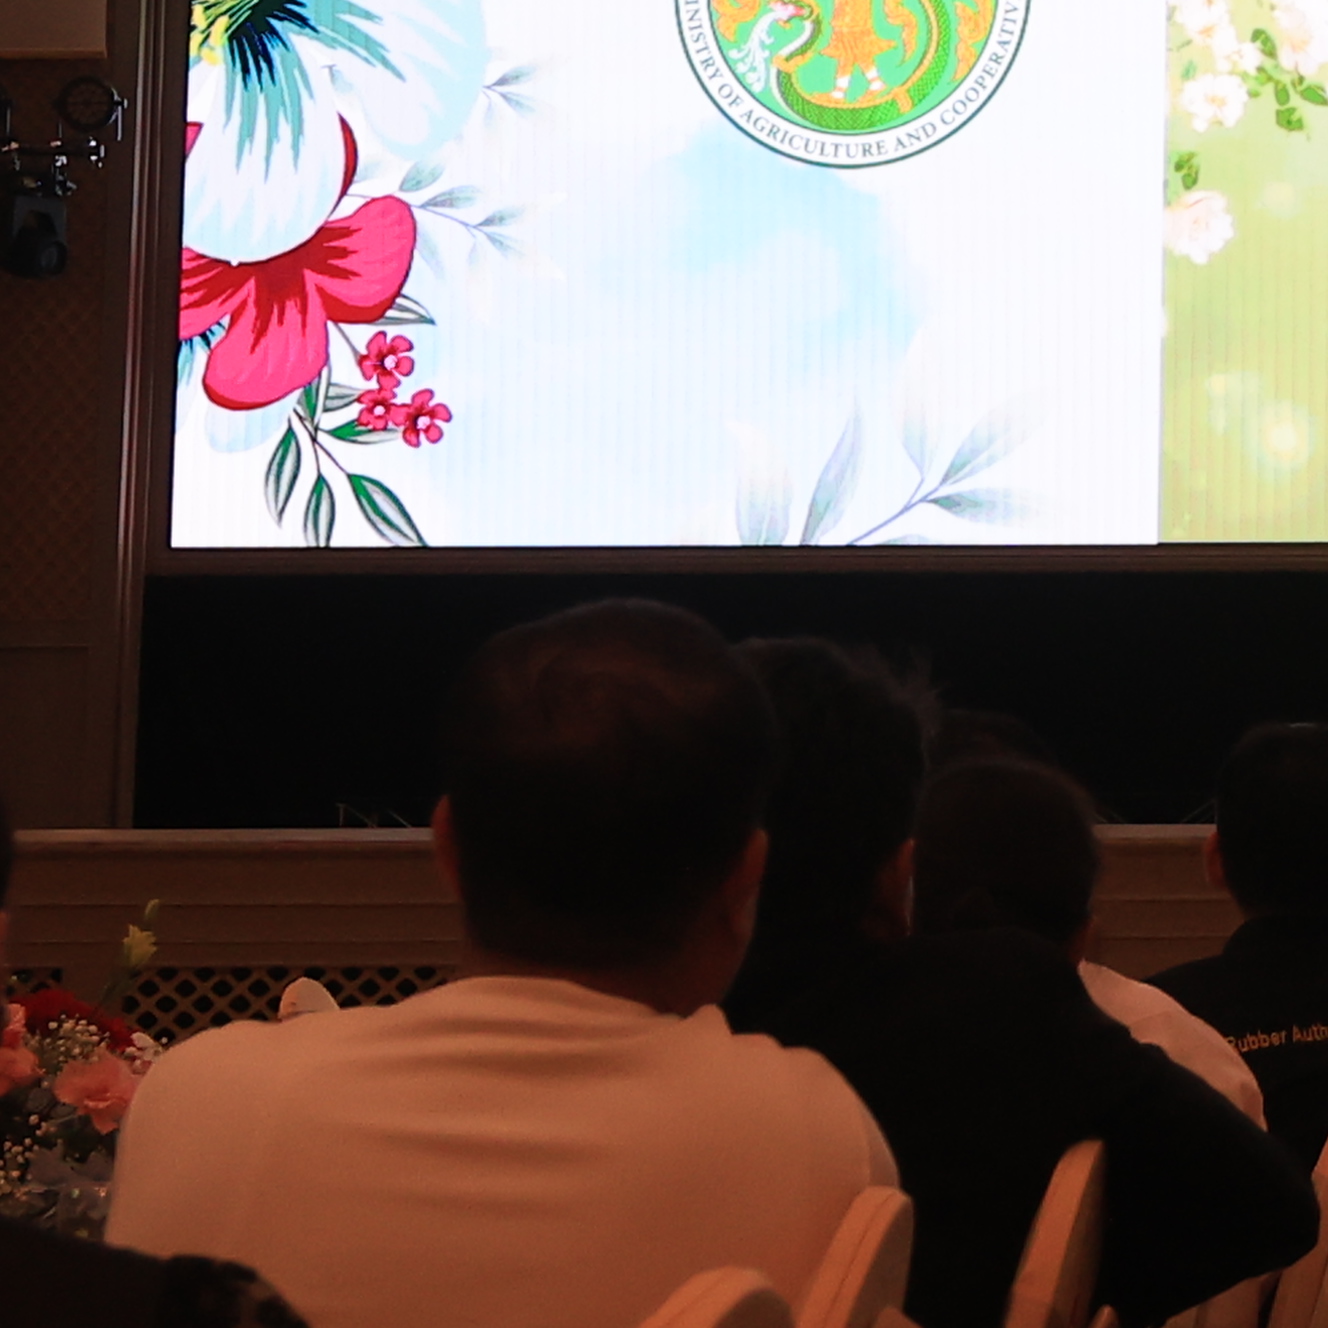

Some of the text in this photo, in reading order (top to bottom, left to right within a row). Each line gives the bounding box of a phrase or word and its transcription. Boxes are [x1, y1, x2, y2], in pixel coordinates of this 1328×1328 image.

[717, 83, 744, 109] OF
[740, 109, 889, 159] AGRICULTURE
[894, 122, 937, 152] AND
